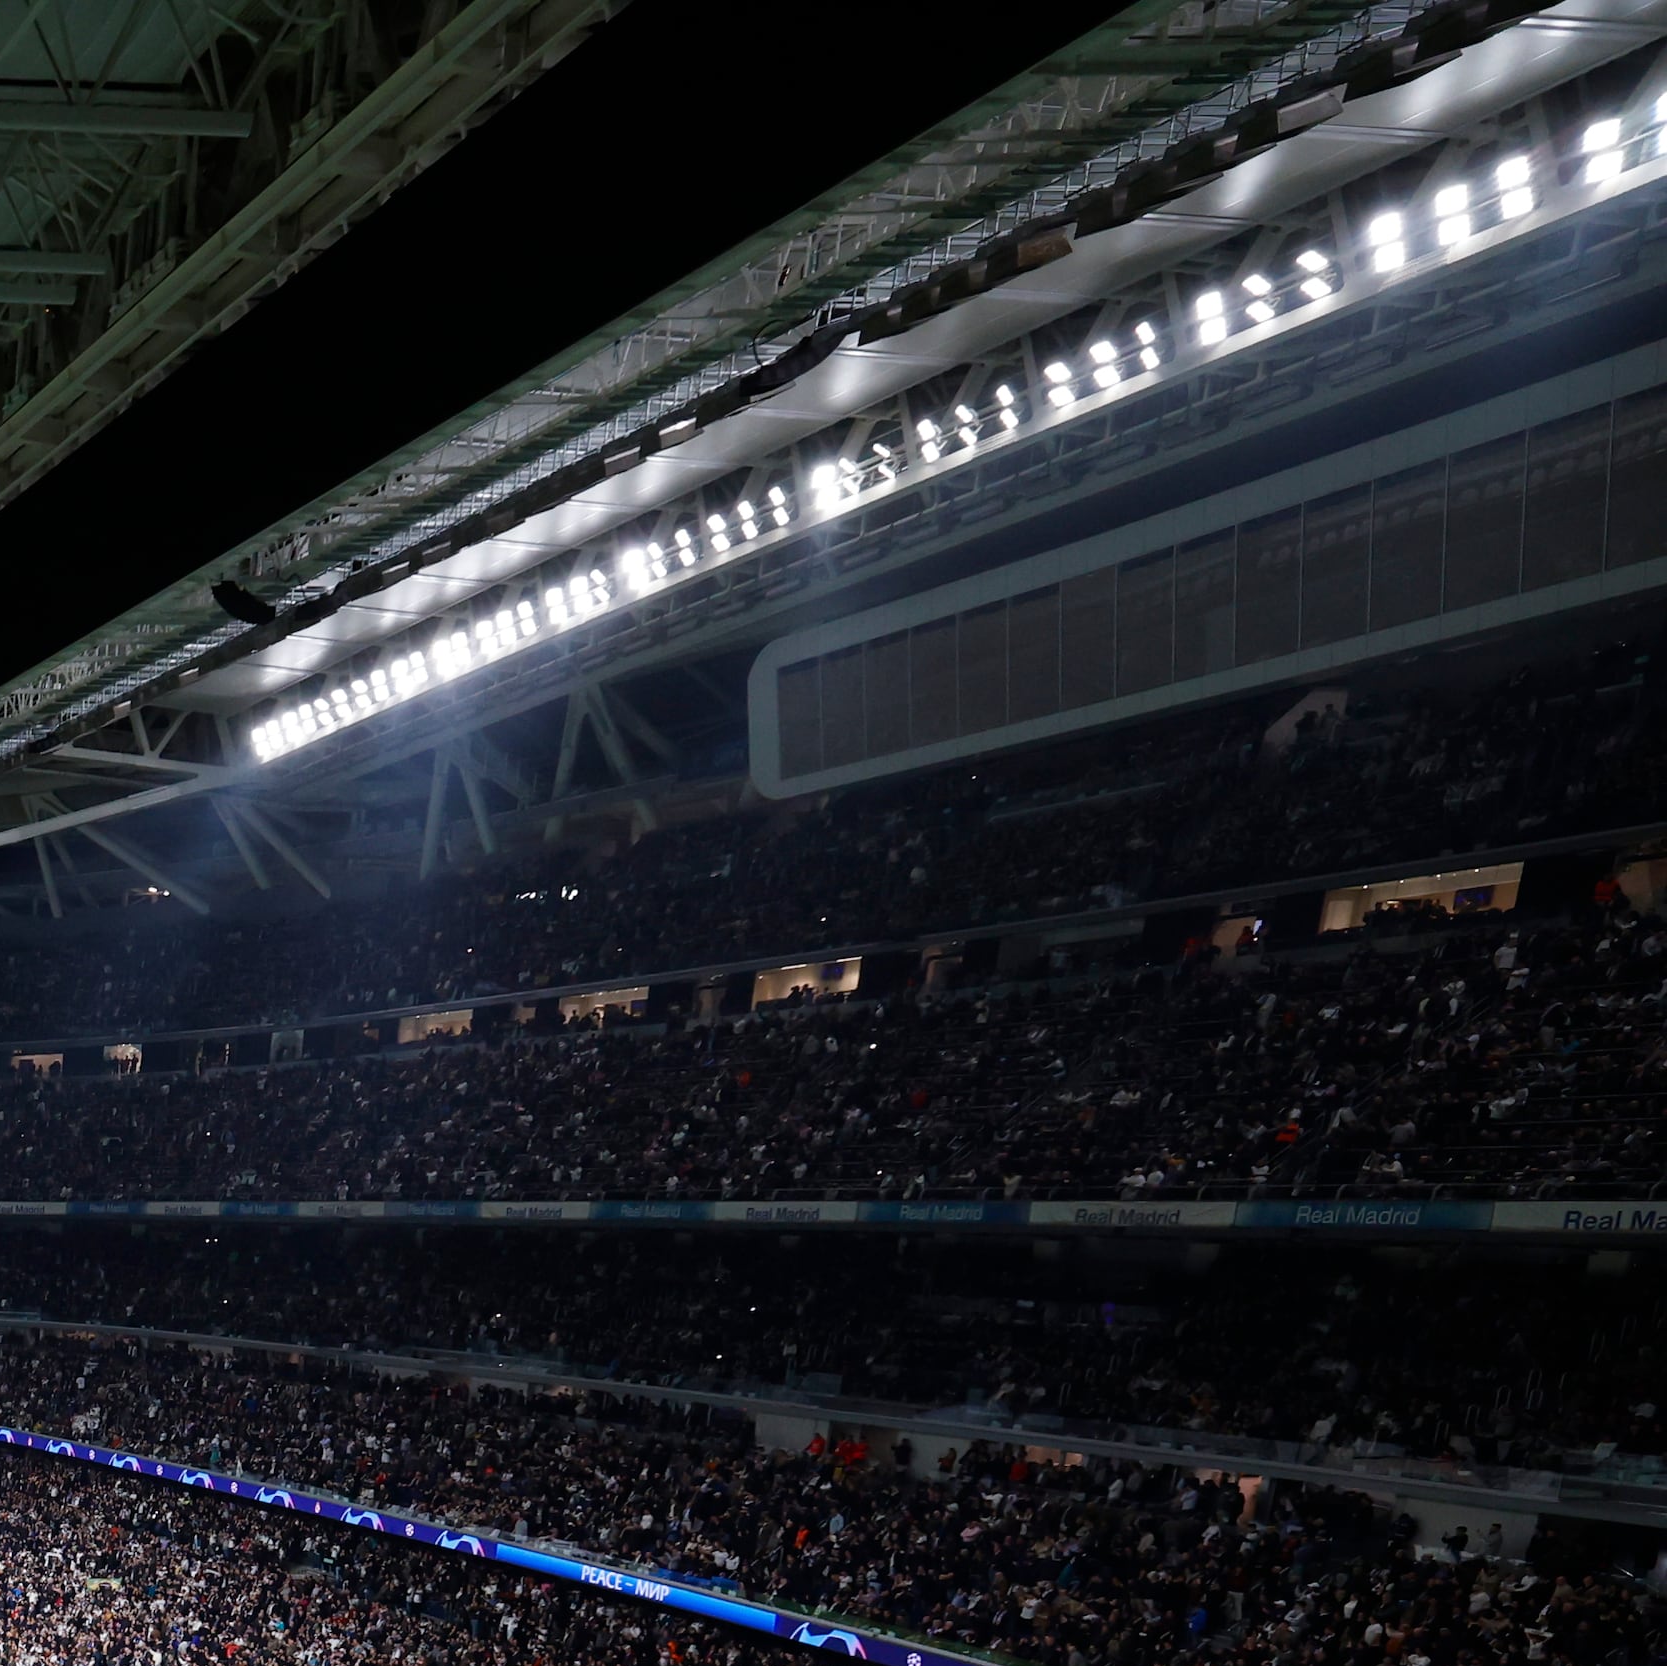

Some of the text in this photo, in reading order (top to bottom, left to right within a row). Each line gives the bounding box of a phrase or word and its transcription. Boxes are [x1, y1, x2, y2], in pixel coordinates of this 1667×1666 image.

[747, 1208, 772, 1220] Real
[900, 1206, 928, 1220] Real
[1075, 1210, 1180, 1224] Real Madrid
[1296, 1206, 1420, 1224] Real Madrid
[1563, 1212, 1622, 1231] Real
[581, 1565, 623, 1590] PEACE
